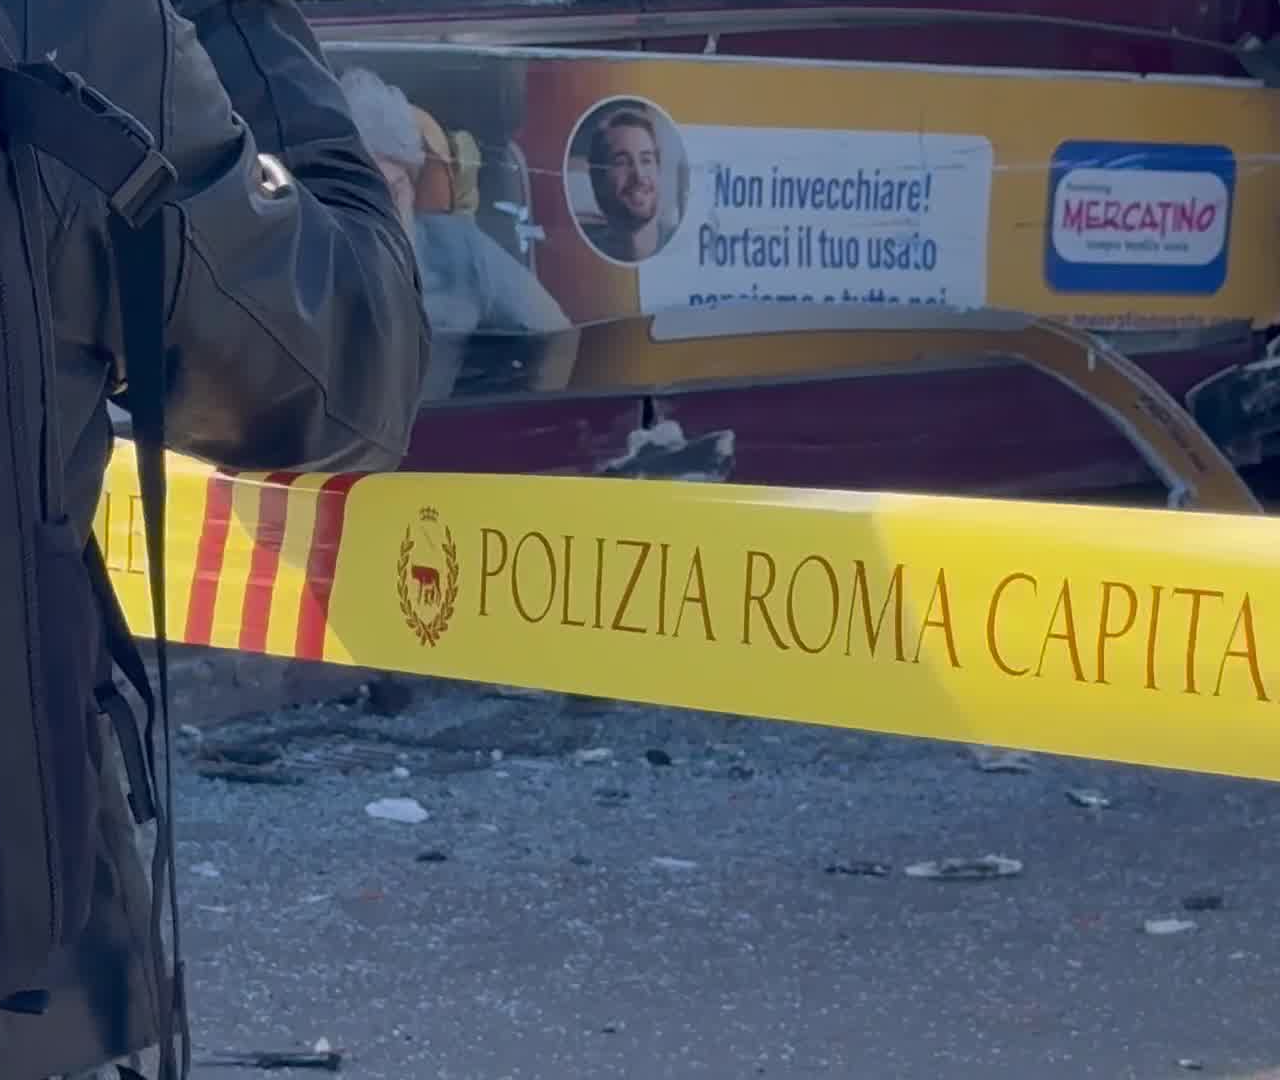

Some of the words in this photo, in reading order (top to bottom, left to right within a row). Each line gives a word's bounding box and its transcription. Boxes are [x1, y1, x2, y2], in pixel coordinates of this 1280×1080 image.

[715, 166, 763, 209] Non
[772, 167, 933, 213] invecchiare!
[1061, 197, 1217, 237] MERCATINO
[698, 223, 790, 269] Portaci
[797, 227, 811, 269] il
[819, 229, 859, 270] tuo
[479, 528, 717, 641] POLIZIA
[741, 550, 962, 668] ROMA
